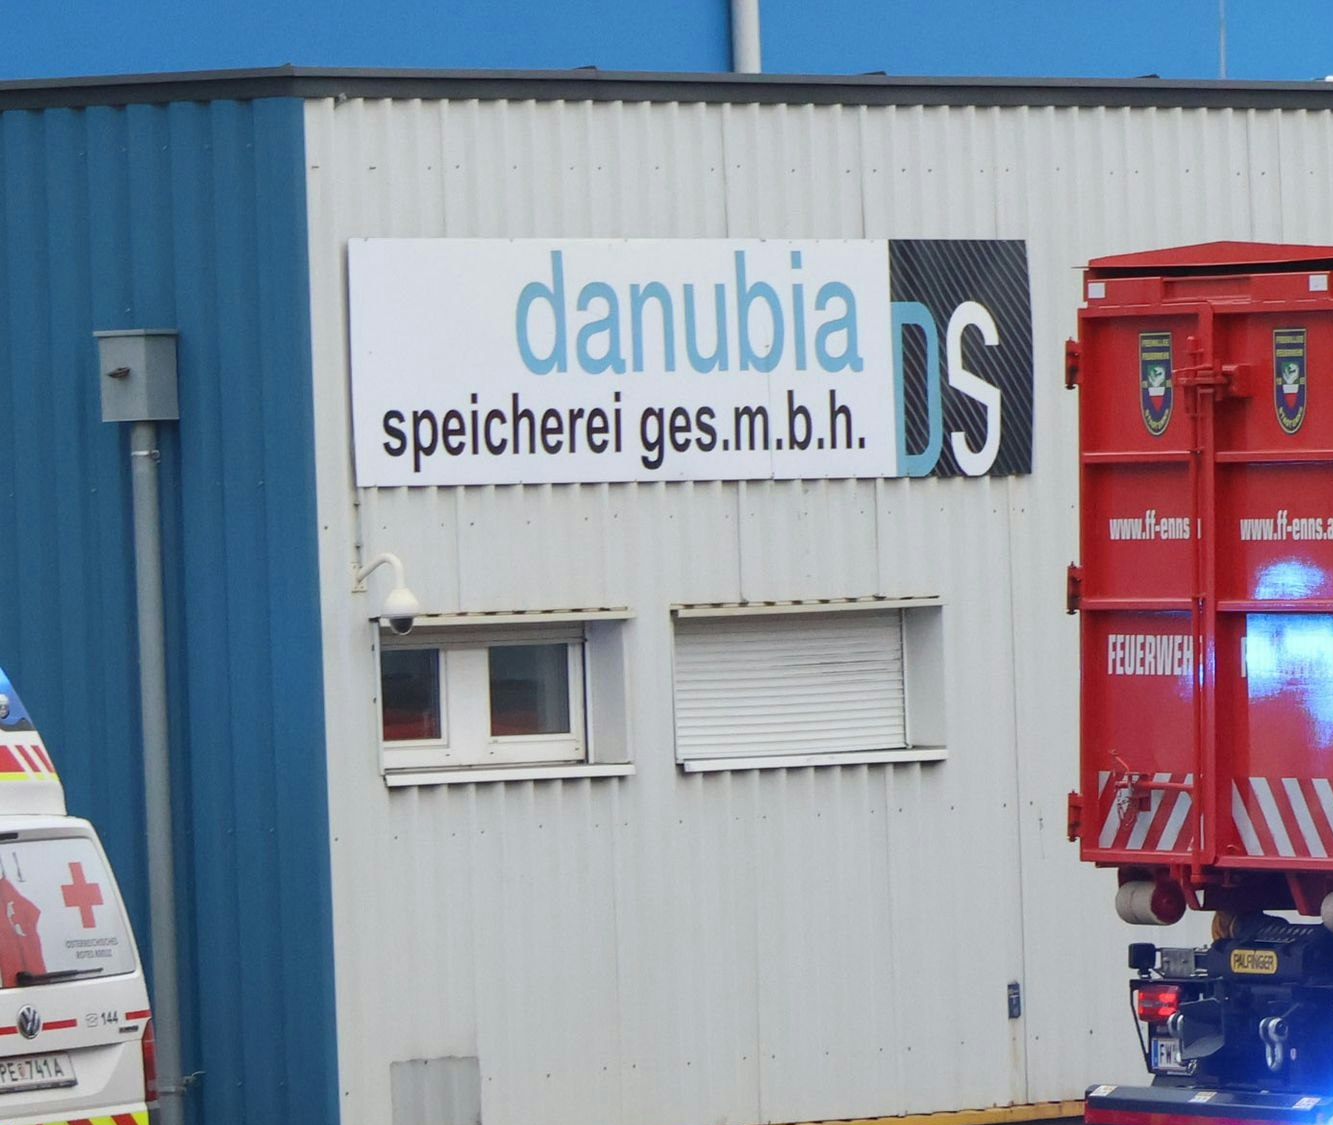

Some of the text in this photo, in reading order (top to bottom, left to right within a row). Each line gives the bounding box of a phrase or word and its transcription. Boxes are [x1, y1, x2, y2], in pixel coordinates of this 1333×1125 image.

[515, 251, 864, 376] danubia
[383, 389, 866, 472] speicherei ges.m.b.h.
[890, 301, 1001, 477] DS
[1108, 634, 1203, 675] FEUERWEH
[101, 1011, 119, 1025] 144
